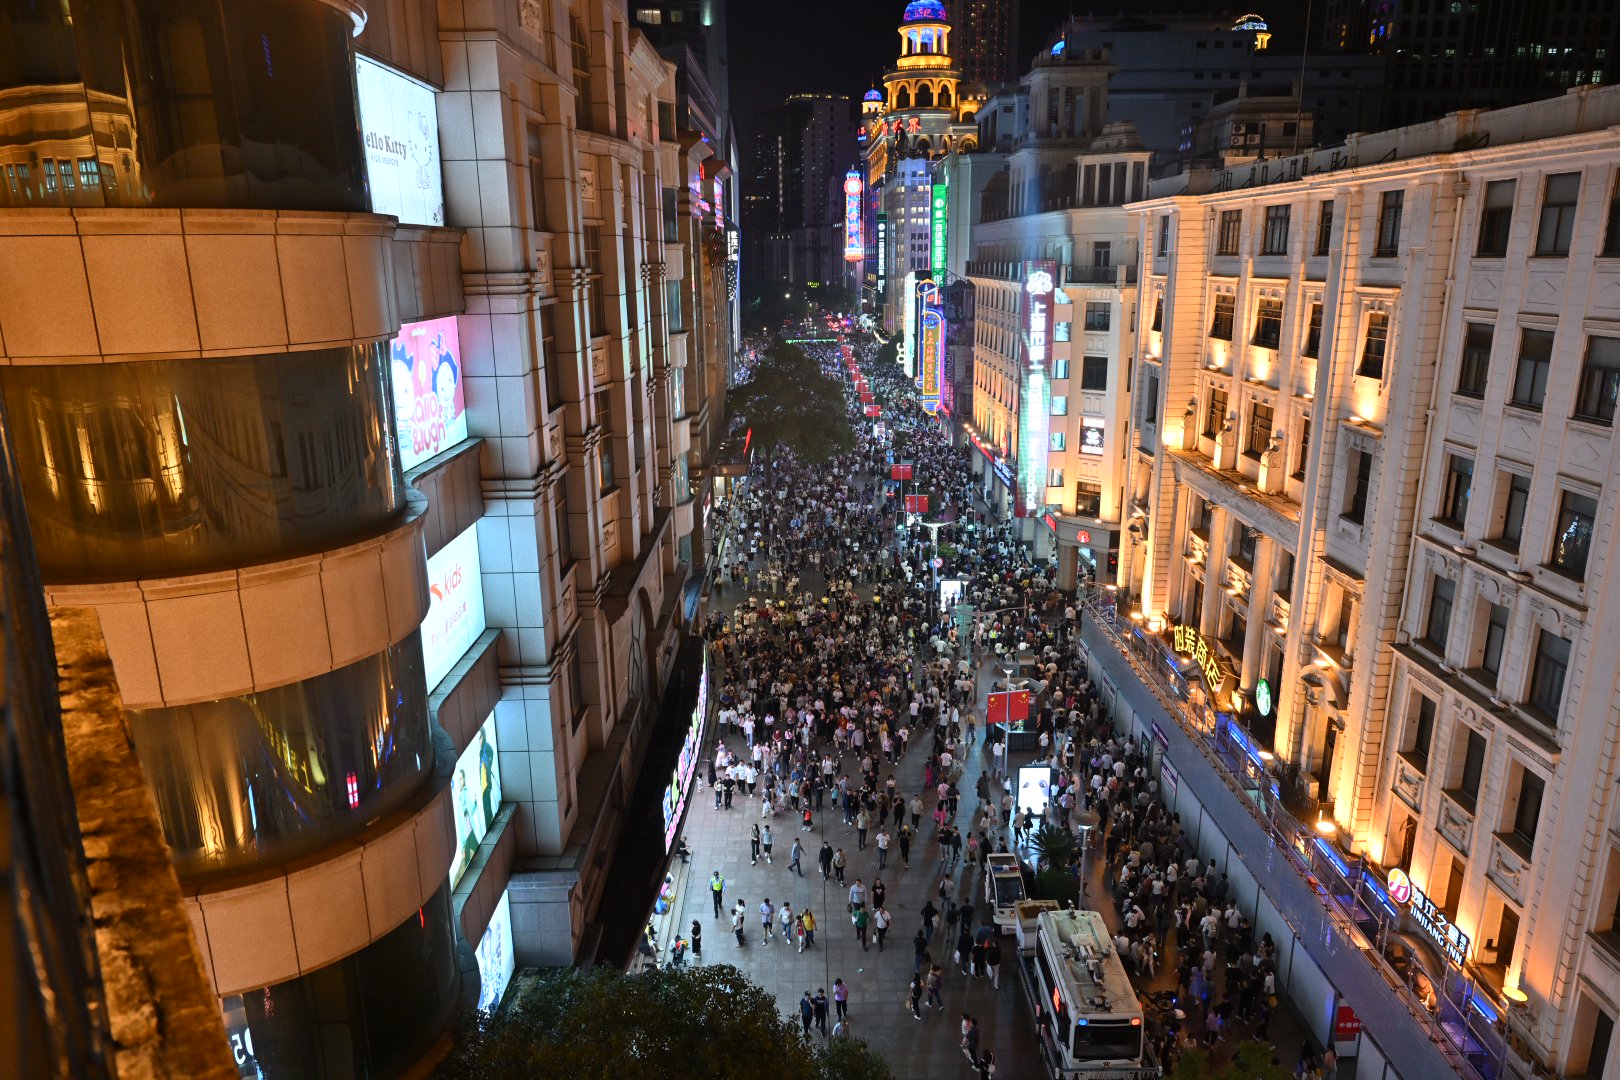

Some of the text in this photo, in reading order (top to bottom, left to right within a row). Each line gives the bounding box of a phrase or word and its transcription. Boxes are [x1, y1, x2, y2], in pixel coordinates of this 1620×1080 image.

[366, 132, 407, 160] ello Kitty
[444, 563, 462, 597] kids
[1174, 624, 1220, 692] 时装商店
[1410, 905, 1463, 965] JINJIANG INN
[1412, 888, 1459, 945] 锦江之星
